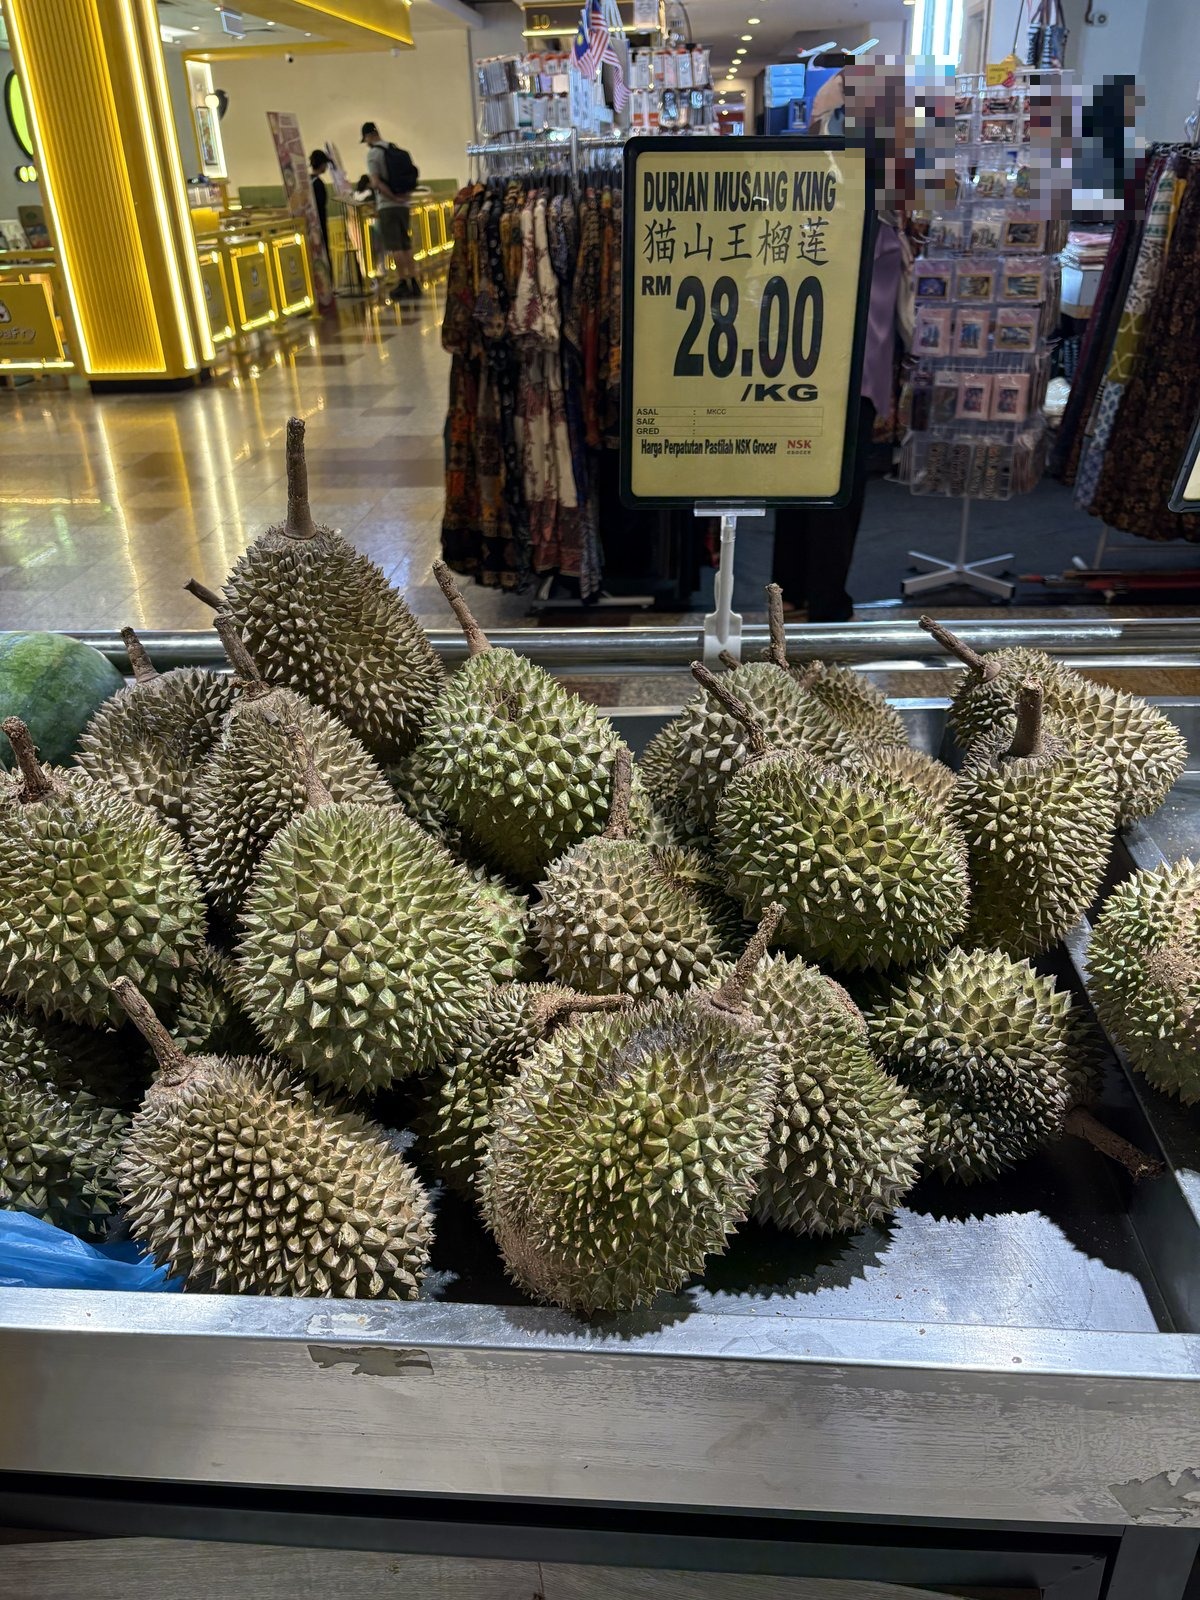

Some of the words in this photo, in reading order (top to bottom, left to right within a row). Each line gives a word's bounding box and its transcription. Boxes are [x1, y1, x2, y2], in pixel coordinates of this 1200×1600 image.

[643, 171, 708, 212] DURIAN
[713, 170, 788, 213] MUSANG
[791, 171, 836, 212] KING
[642, 216, 830, 266] 猫山王榴莲
[641, 275, 671, 296] RM
[673, 275, 824, 379] 28.00
[740, 383, 819, 402] /KG
[636, 408, 659, 416] ASAL
[636, 418, 656, 426] SAIZ
[636, 427, 660, 435] GRED
[641, 439, 663, 458] Harga
[664, 439, 703, 458] Perpatutan
[704, 439, 734, 455] Pastilah
[735, 439, 752, 455] NSK
[752, 439, 777, 455] Grocer
[787, 439, 812, 449] NSK
